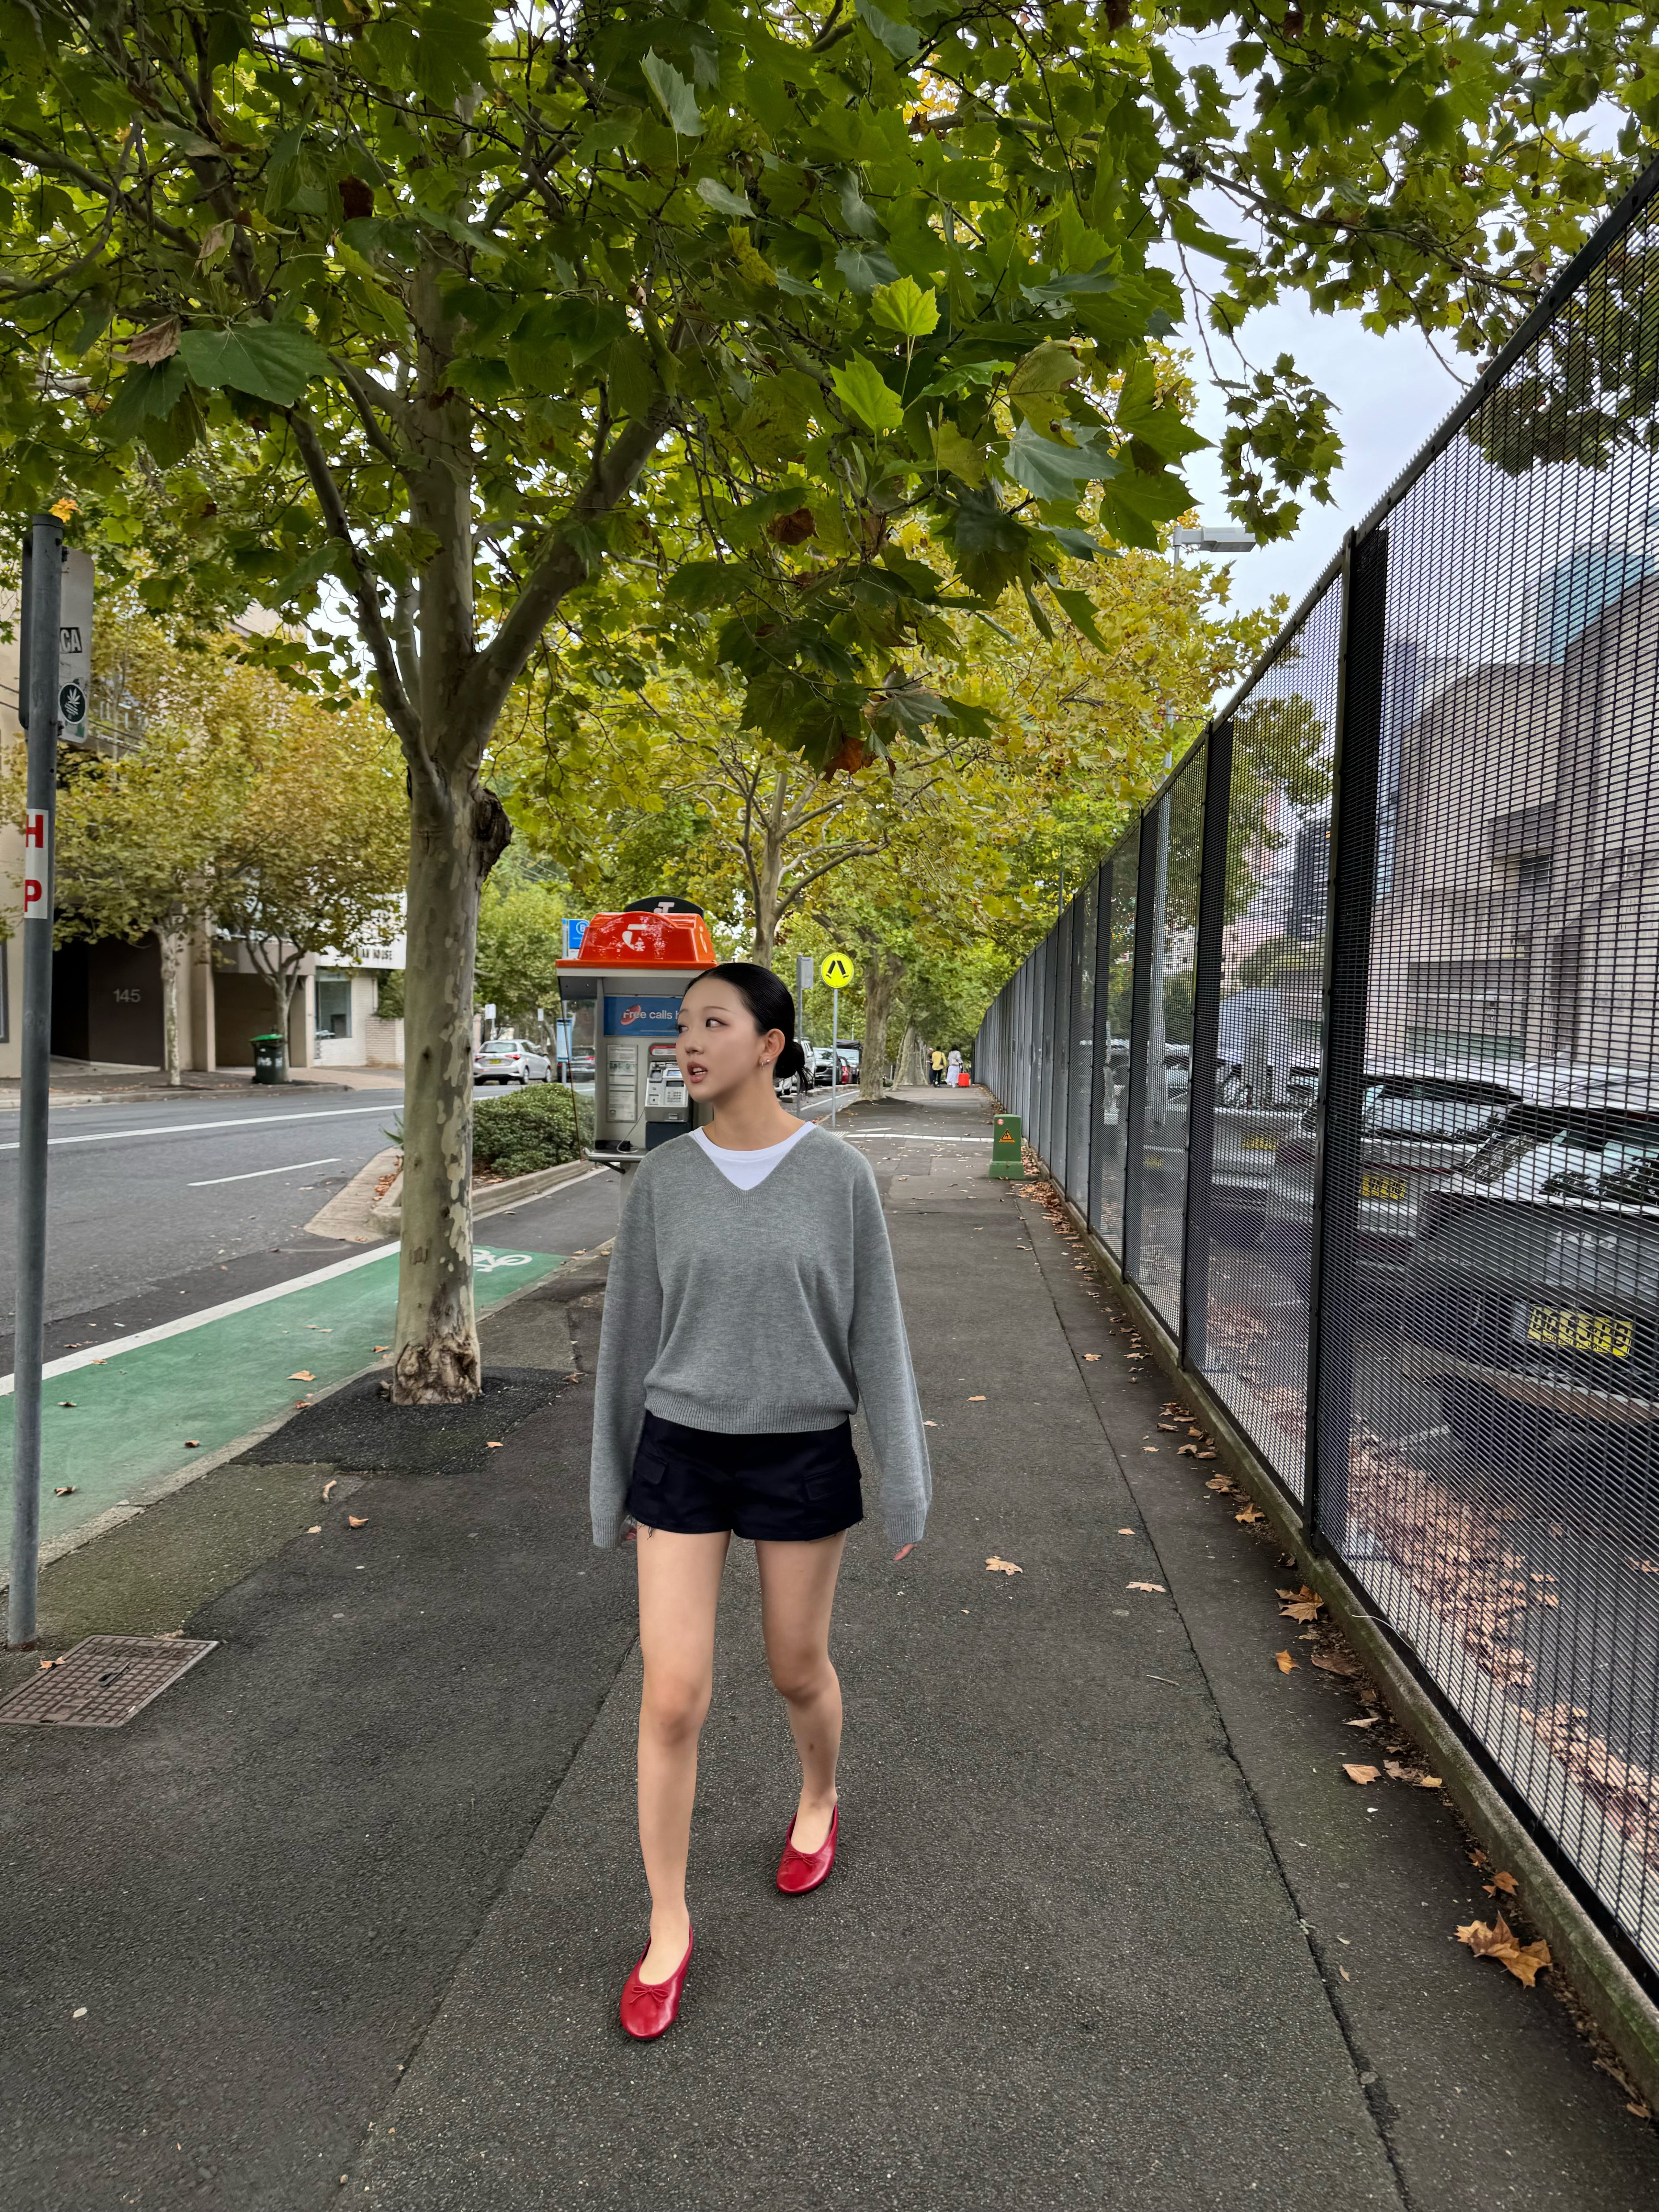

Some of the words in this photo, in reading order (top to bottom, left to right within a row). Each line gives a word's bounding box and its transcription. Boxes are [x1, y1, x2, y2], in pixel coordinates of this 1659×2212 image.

[60, 629, 81, 653] CA
[26, 814, 44, 848] H
[24, 879, 42, 912] P
[113, 988, 141, 1003] 145
[623, 1008, 646, 1019] Free
[649, 1010, 673, 1019] calls
